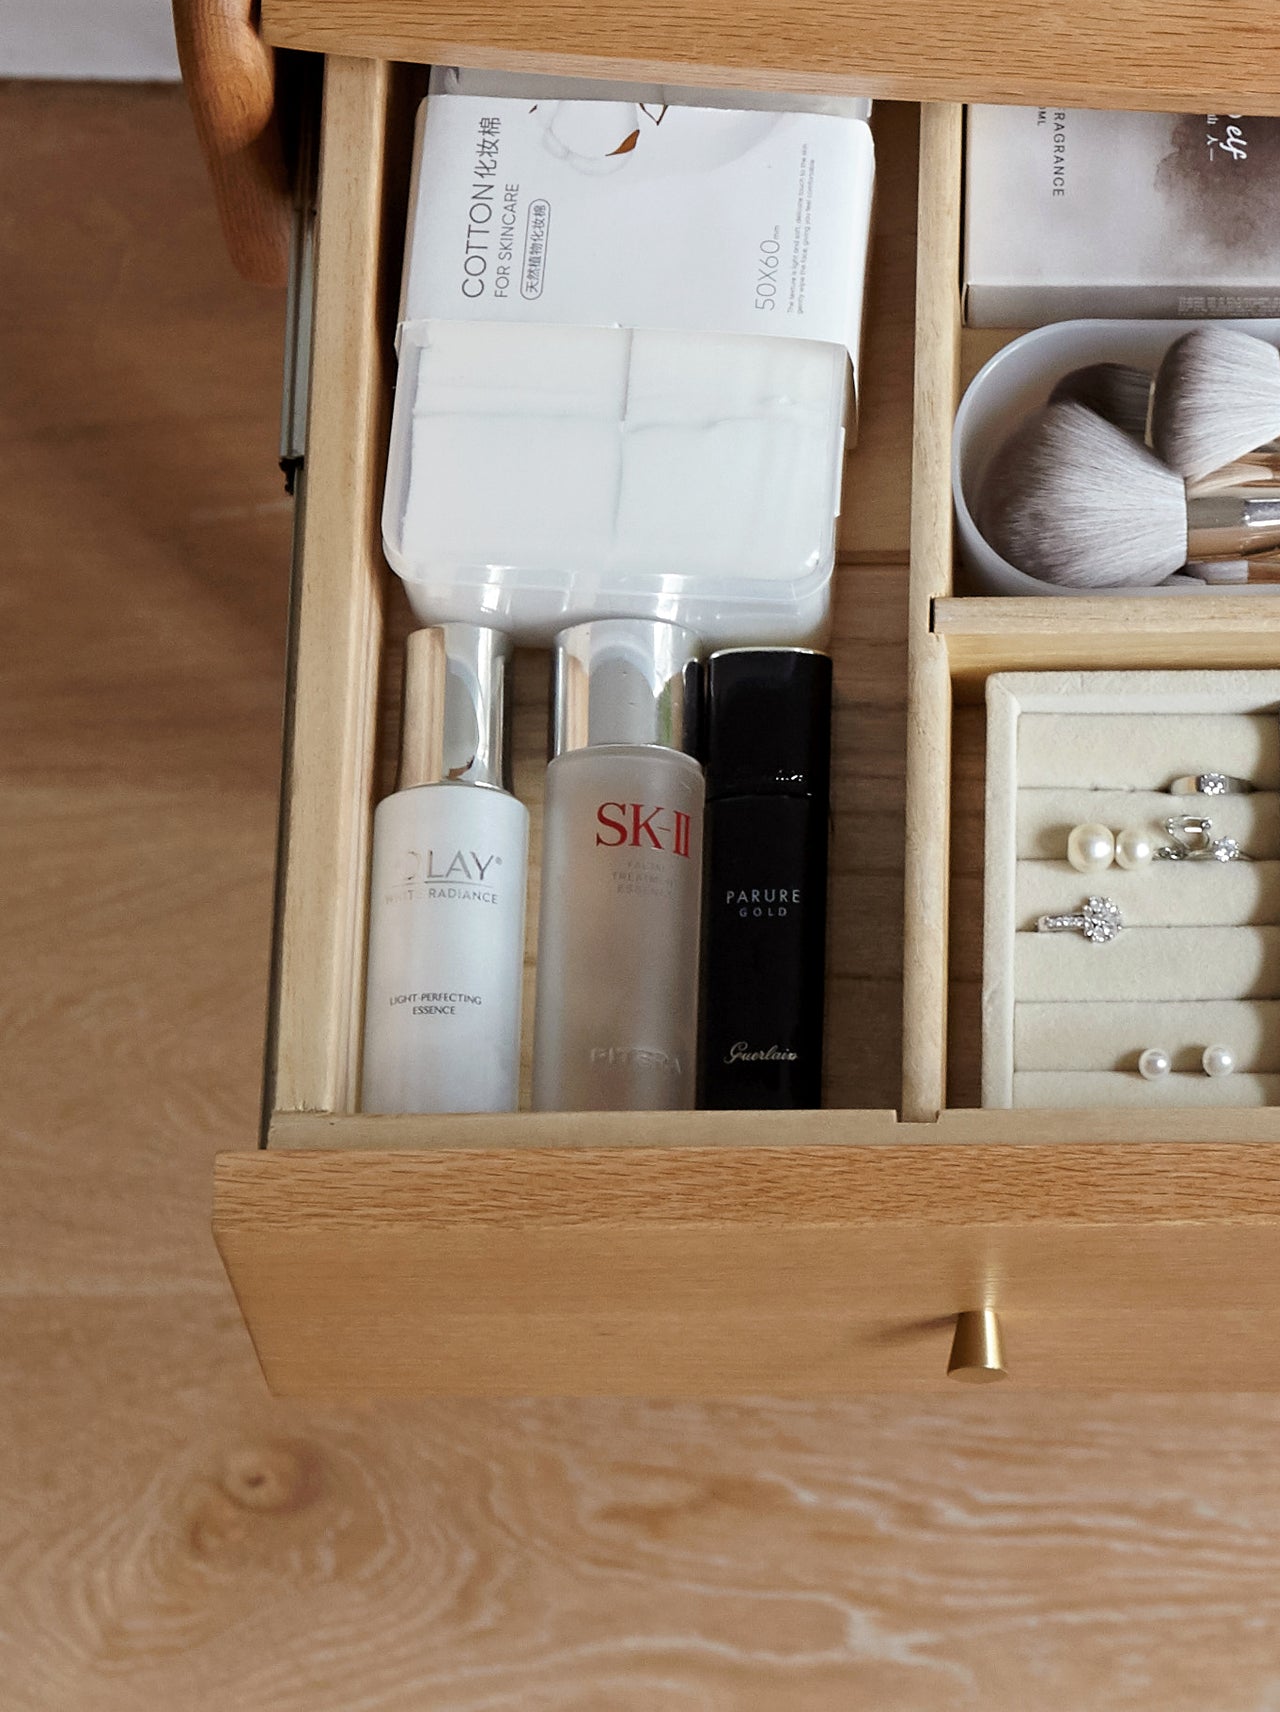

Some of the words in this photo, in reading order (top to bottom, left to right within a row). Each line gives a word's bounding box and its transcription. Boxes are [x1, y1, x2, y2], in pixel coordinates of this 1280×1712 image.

[472, 116, 503, 180] 化妆棉
[1052, 108, 1066, 197] RAGRANCE
[498, 182, 521, 262] SKINCARE
[461, 183, 495, 299] COTTON
[493, 264, 512, 299] FOR
[595, 801, 692, 860] SK-II
[428, 888, 499, 905] RADIANCE
[726, 889, 801, 904] PARURE
[739, 906, 788, 918] GOLD
[412, 1005, 457, 1016] ESSENCE
[723, 1040, 798, 1065] Guerlain
